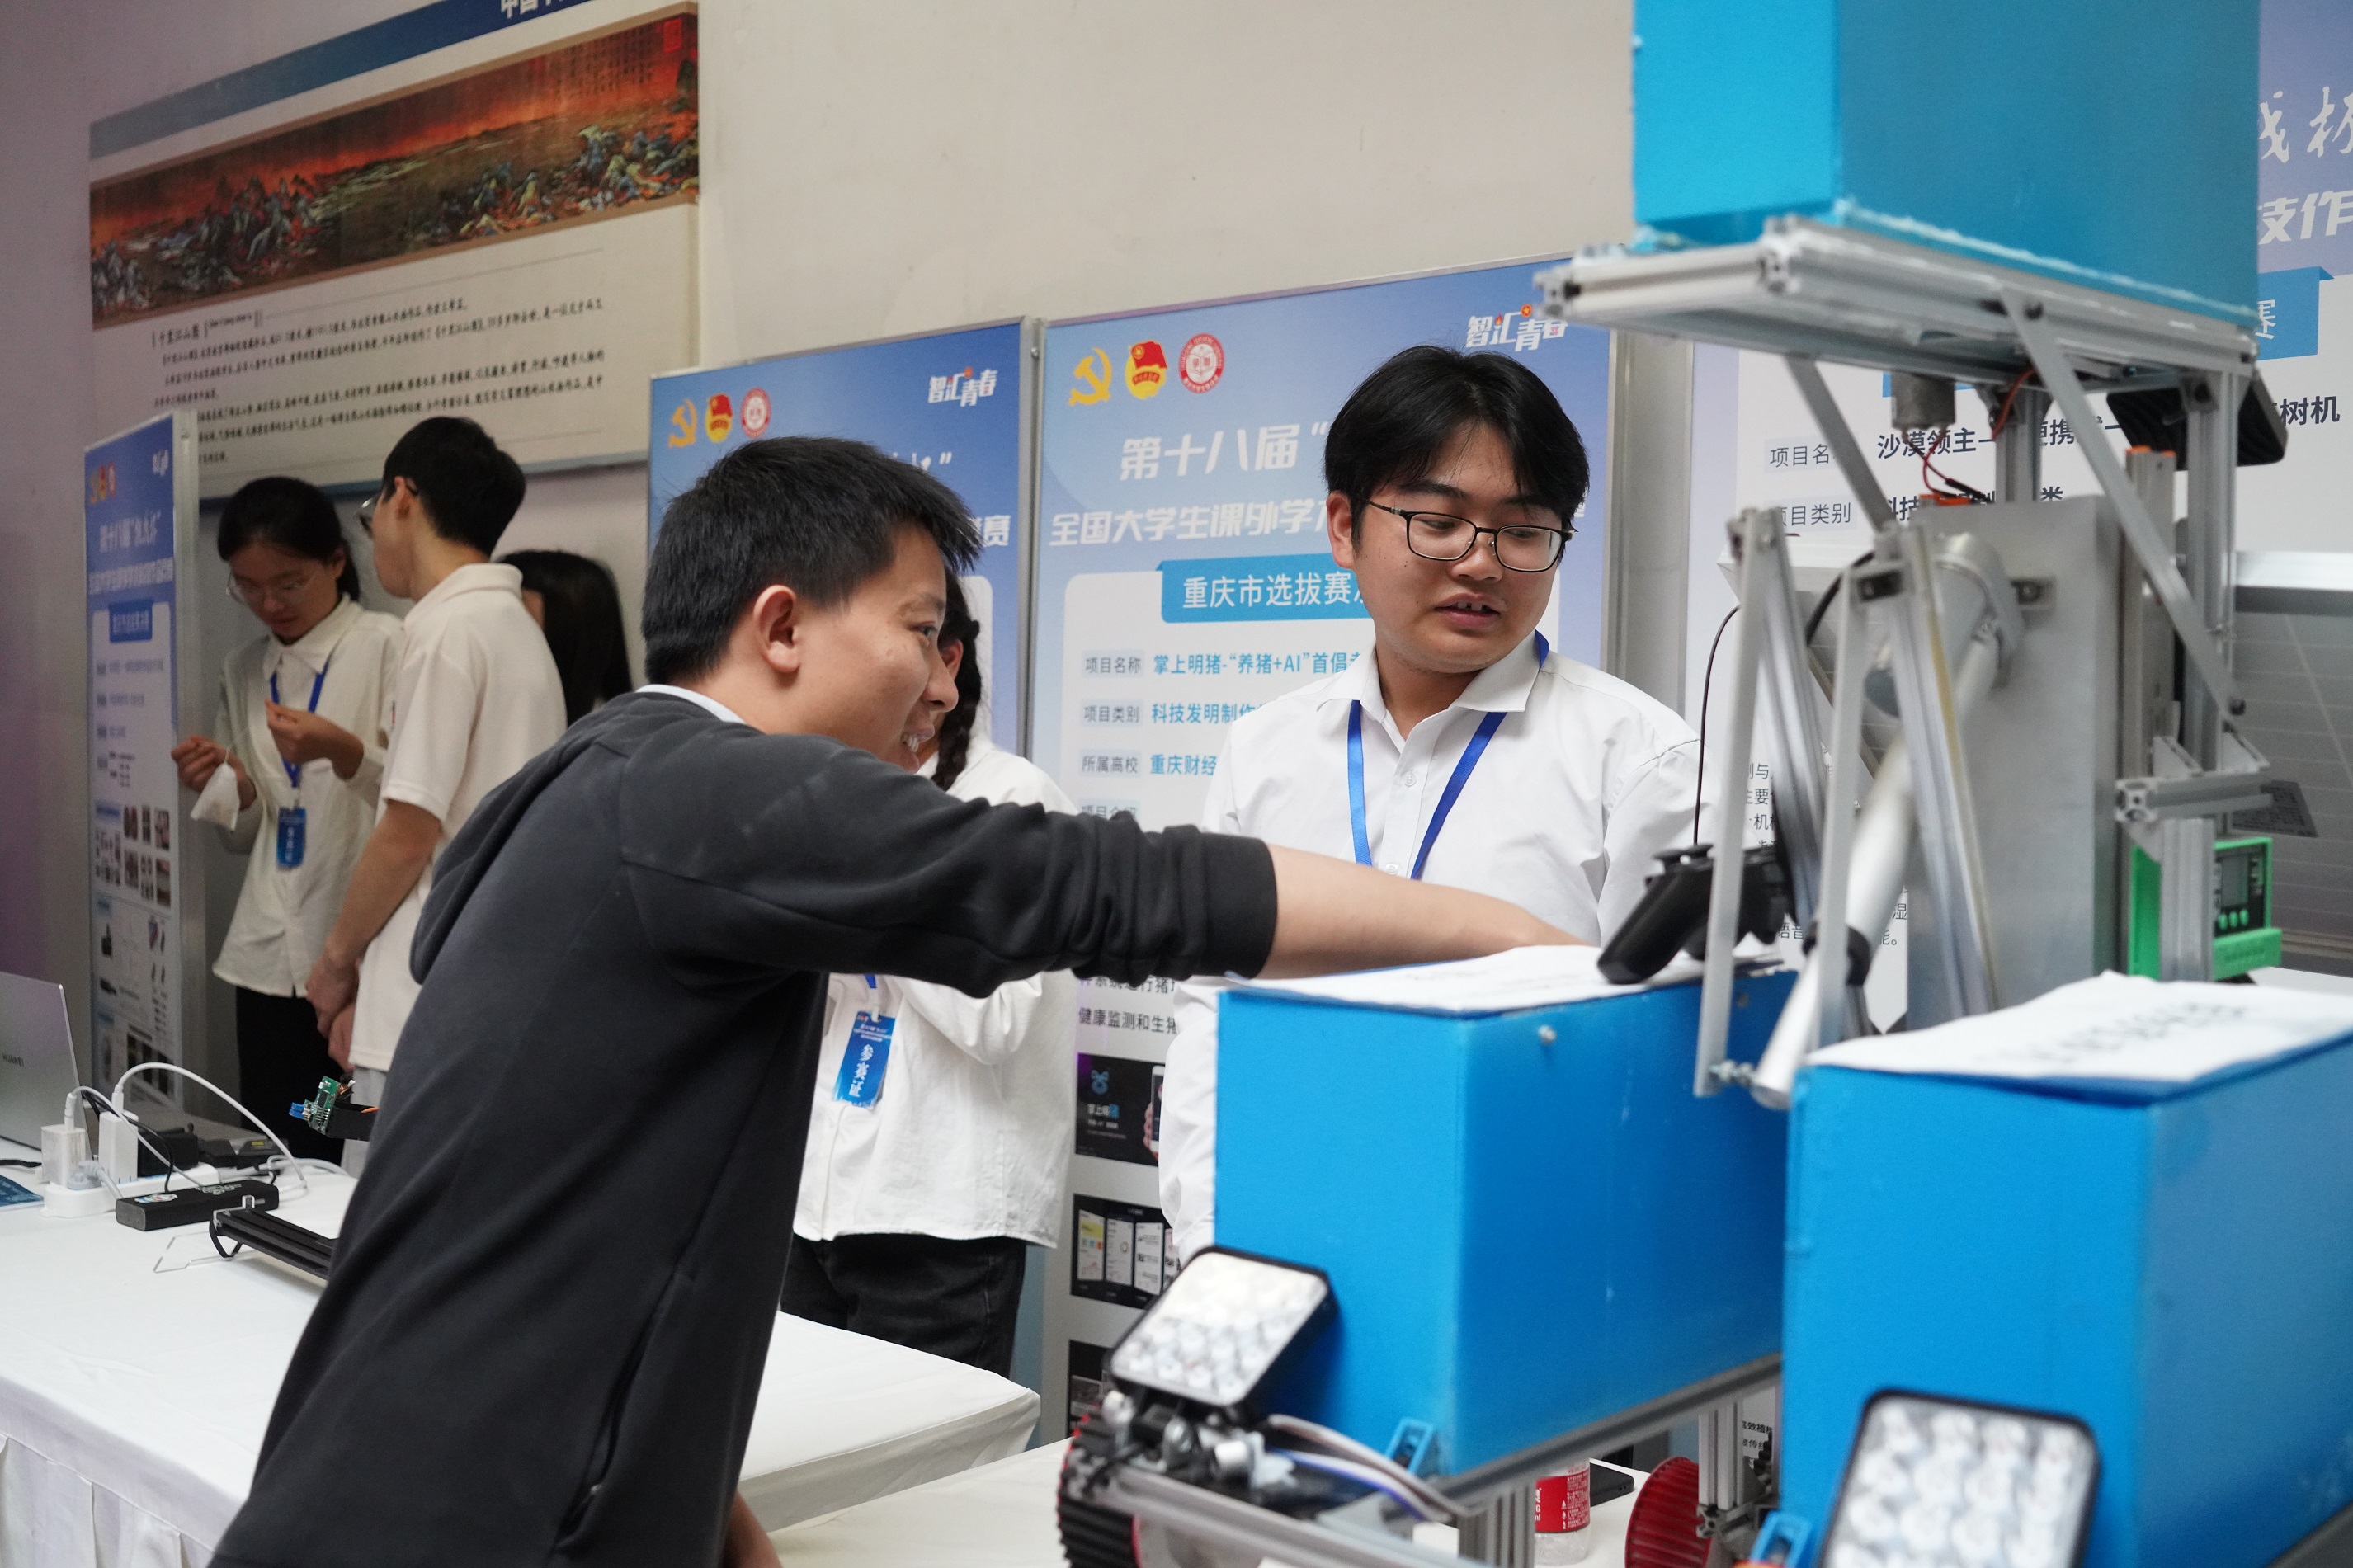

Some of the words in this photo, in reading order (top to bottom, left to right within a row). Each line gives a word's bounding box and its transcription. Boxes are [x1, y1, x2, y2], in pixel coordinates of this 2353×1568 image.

[927, 368, 998, 407] 智汇青春
[1770, 444, 1835, 468] 项目名
[2273, 395, 2341, 427] 树机
[1181, 570, 1365, 610] 重庆市选拔赛
[1085, 656, 1142, 675] 项目名称
[1084, 704, 1140, 723] 项目类别
[1082, 755, 1139, 774] 所属高校
[1078, 1006, 1177, 1034] 健康监测和生猪
